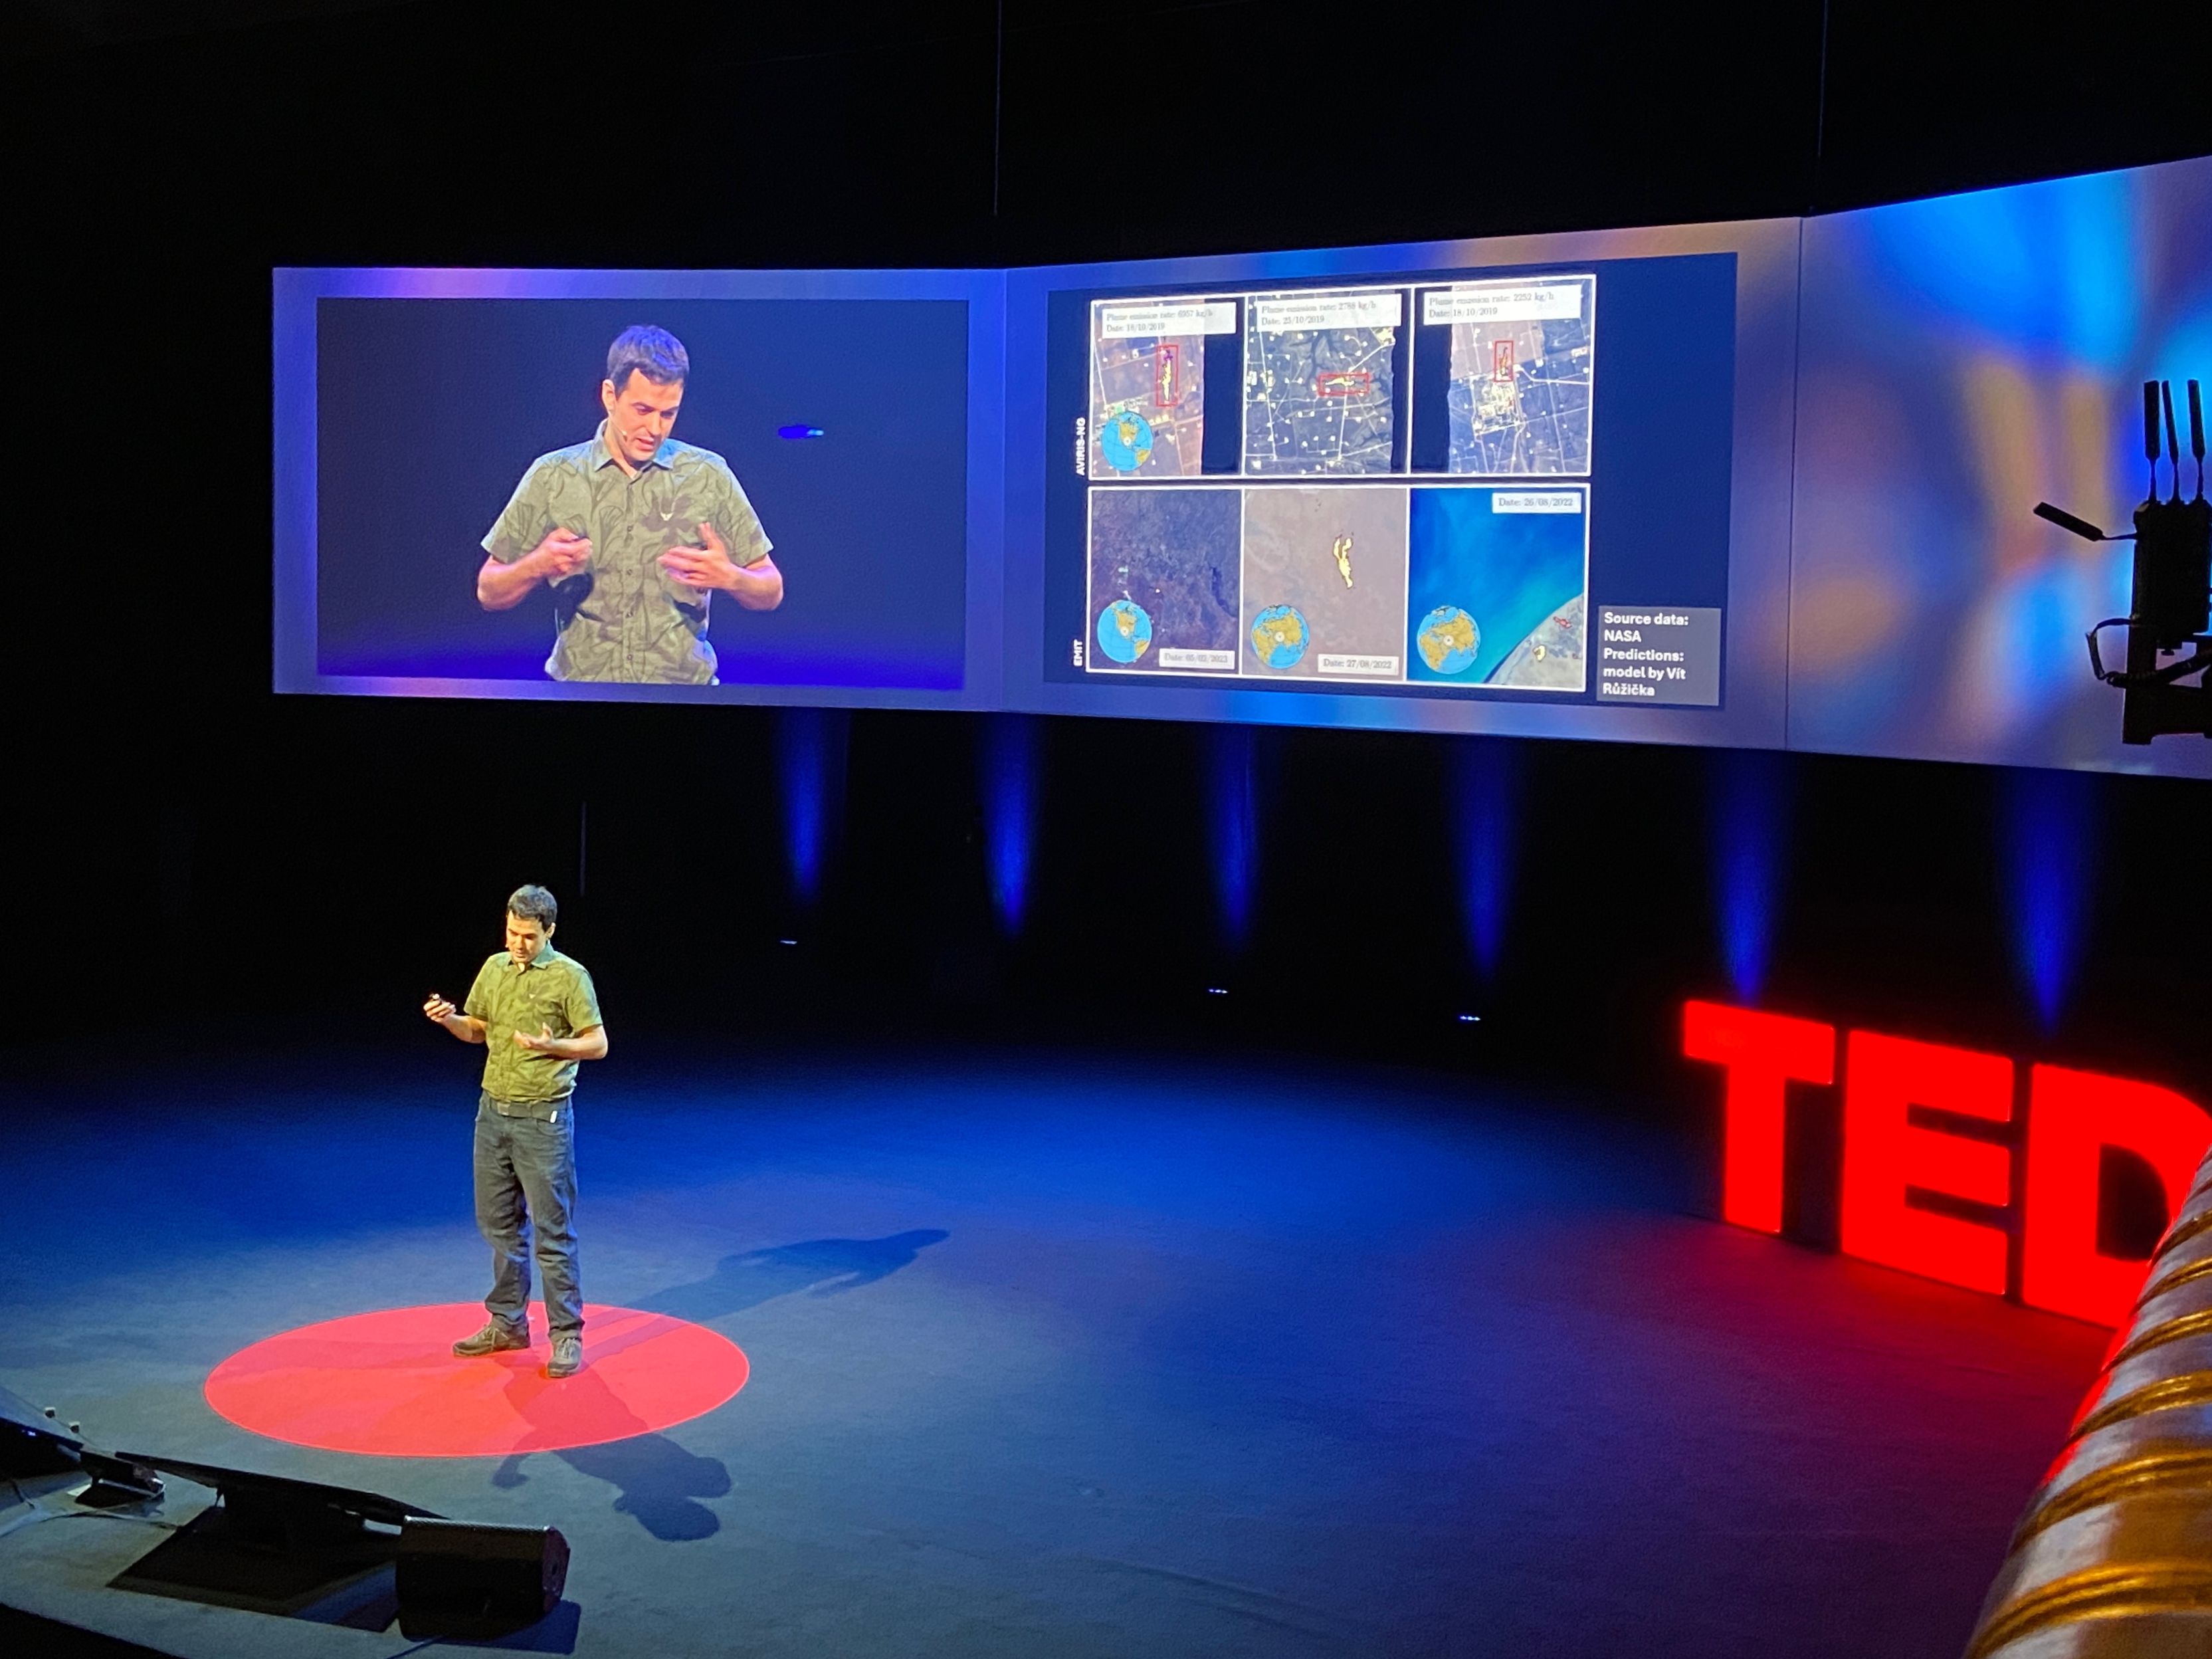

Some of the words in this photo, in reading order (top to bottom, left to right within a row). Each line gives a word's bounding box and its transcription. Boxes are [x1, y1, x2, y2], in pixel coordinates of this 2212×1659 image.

[1429, 309, 1451, 318] Date:
[1261, 317, 1280, 326] Date:
[1498, 498, 1521, 506] Date:
[1604, 611, 1652, 625] Source
[1653, 613, 1689, 625] data:
[1604, 629, 1642, 642] NASA
[1073, 639, 1083, 666] EMIT
[1603, 647, 1684, 662] Predictions:
[1323, 658, 1345, 667] Date:
[1603, 666, 1646, 678] model
[1648, 666, 1665, 681] by
[1666, 667, 1686, 680] Vít
[1603, 682, 1655, 697] Růžička
[1682, 1000, 2212, 1331] TED
